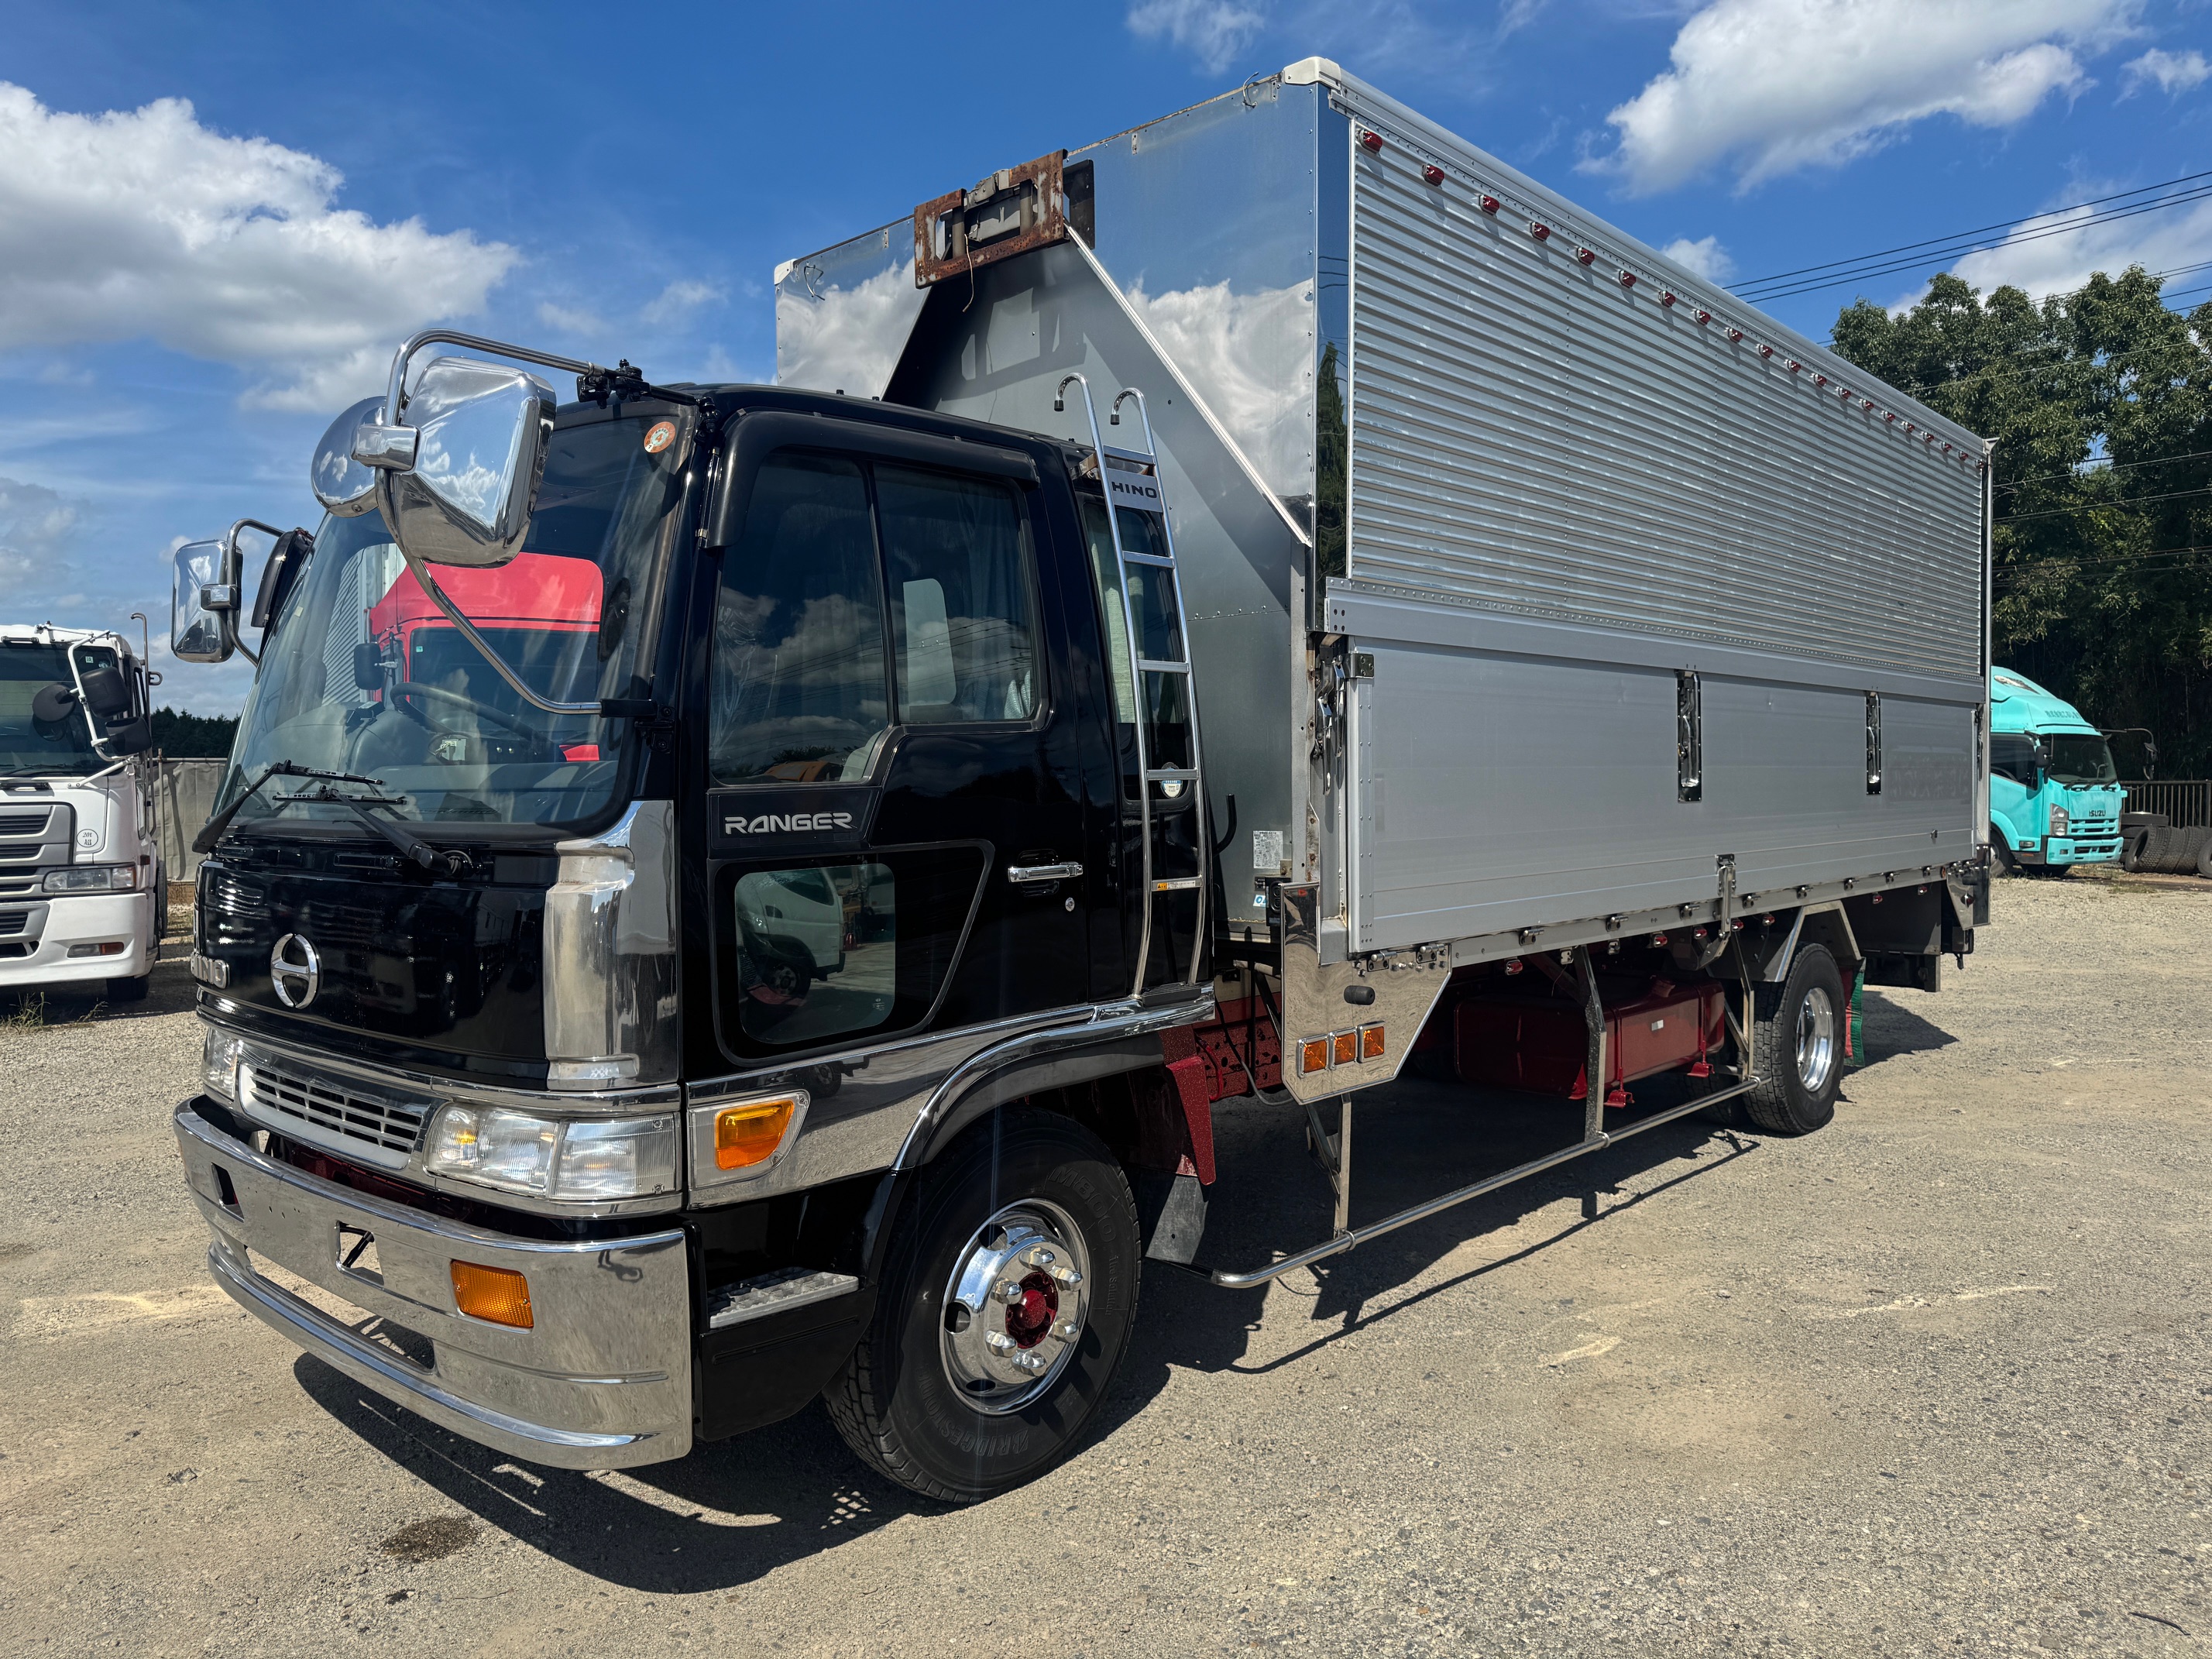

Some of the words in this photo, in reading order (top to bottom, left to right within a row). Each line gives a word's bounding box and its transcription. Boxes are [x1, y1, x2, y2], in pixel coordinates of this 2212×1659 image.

[1111, 481, 1157, 499] HINO
[725, 812, 853, 835] RANGER
[1048, 1165, 1117, 1243] M800
[915, 1365, 1029, 1458] BRIDGESTONE
